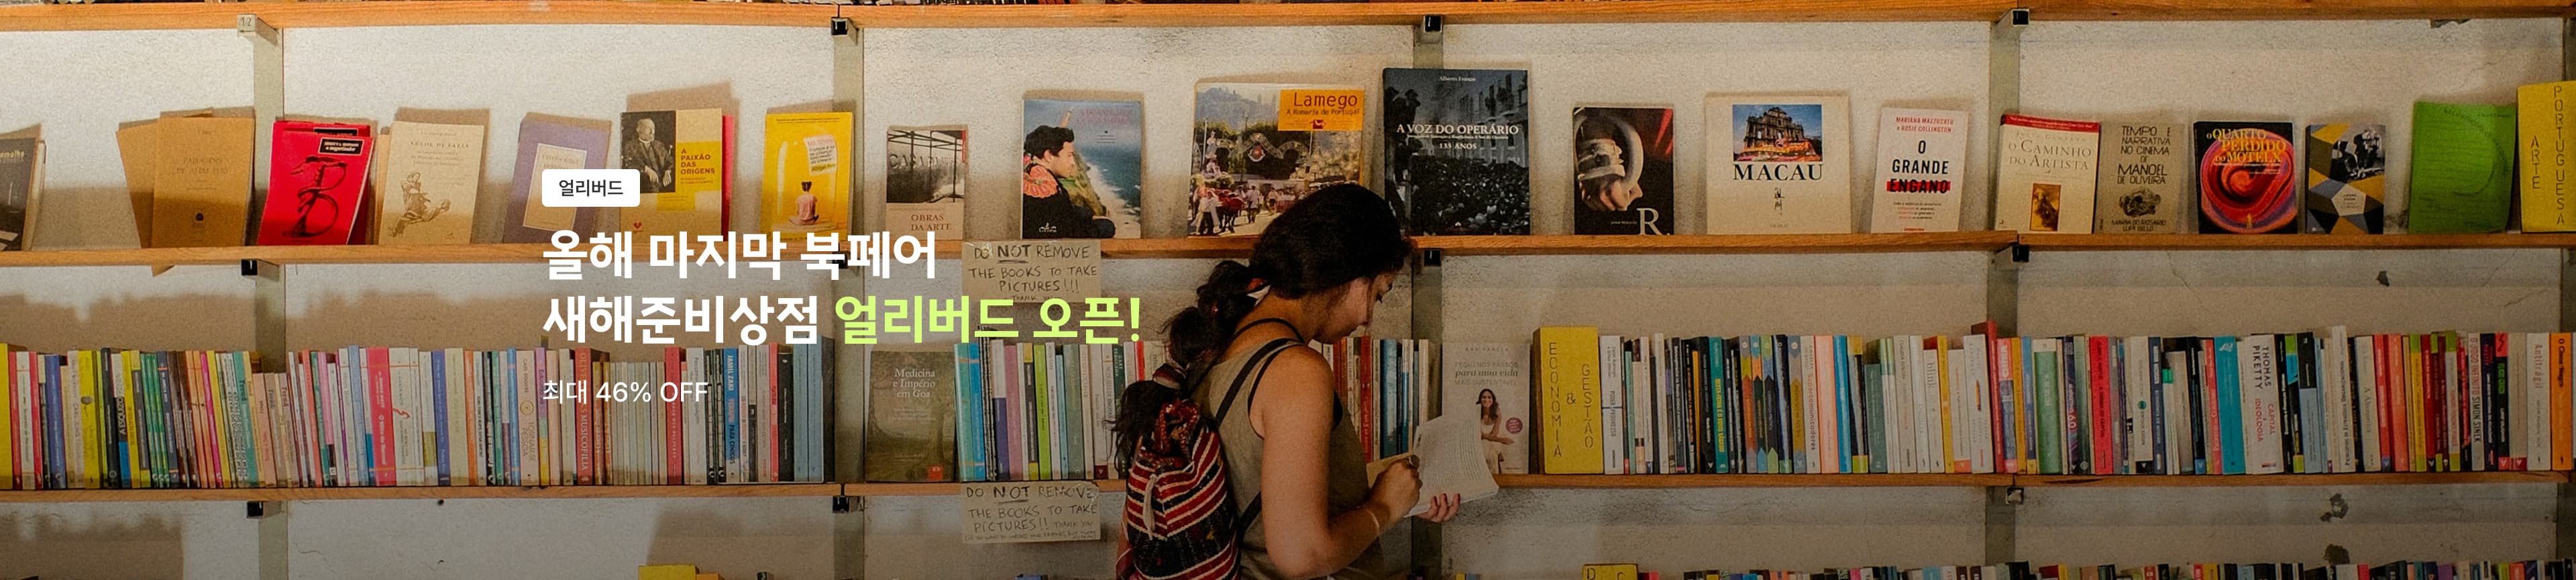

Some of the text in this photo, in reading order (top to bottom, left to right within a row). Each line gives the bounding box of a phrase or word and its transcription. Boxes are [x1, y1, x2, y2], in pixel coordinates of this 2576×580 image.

[1293, 92, 1358, 109] Lamego
[1331, 108, 1360, 116] Portugal
[1896, 117, 1921, 125] MARIANA
[1396, 124, 1519, 135] A VOZ DO OPERÁRIO
[2121, 126, 2157, 136] TEMPO
[2212, 129, 2267, 141] QUARTO
[1918, 140, 1926, 154] O
[2121, 136, 2171, 146] NARRATIVA
[2221, 140, 2286, 152] PERDIDO
[2008, 140, 2092, 157] O CAMINHO
[2121, 146, 2169, 155] NO CINEMA
[681, 152, 711, 161] PAIXÃO
[2140, 154, 2147, 162] DE
[2530, 135, 2540, 189] ARTE
[680, 167, 716, 175] ORIGENS
[1892, 159, 1949, 175] GRANDE
[2010, 155, 2088, 173] DO ARTISTA
[2117, 163, 2168, 176] MANOEL
[1733, 163, 1824, 181] MACAU
[1889, 179, 1948, 194] ENGANO
[2116, 175, 2166, 185] DE OLIVEIRA
[911, 213, 945, 222] OBRAS
[910, 223, 952, 232] DA ARTE
[974, 244, 1091, 259] DO NOT REMOVE
[967, 265, 1097, 279] THE BOOKS TO TAKE
[894, 368, 936, 377] Medicina
[2253, 345, 2263, 390] PIKETTY
[2262, 346, 2272, 387] THOMAS
[1455, 371, 1477, 379] para
[1926, 362, 1937, 389] blink
[900, 379, 936, 391] Império
[913, 389, 930, 398] Goa
[1549, 342, 1562, 458] ECONOMIA
[1566, 392, 1576, 405] &
[1582, 363, 1594, 448] GESTÃO
[1807, 373, 1816, 451] Supercomunicadores
[2255, 397, 2264, 442] IDEOLOGIA
[2267, 403, 2276, 435] CAPITAL
[2471, 397, 2481, 443] SIMON SINEK
[580, 414, 588, 471] MUSICOFILIA
[966, 485, 1094, 499] DO NOT REMOVE
[967, 504, 1097, 519] THE BOOKS TO TAKE
